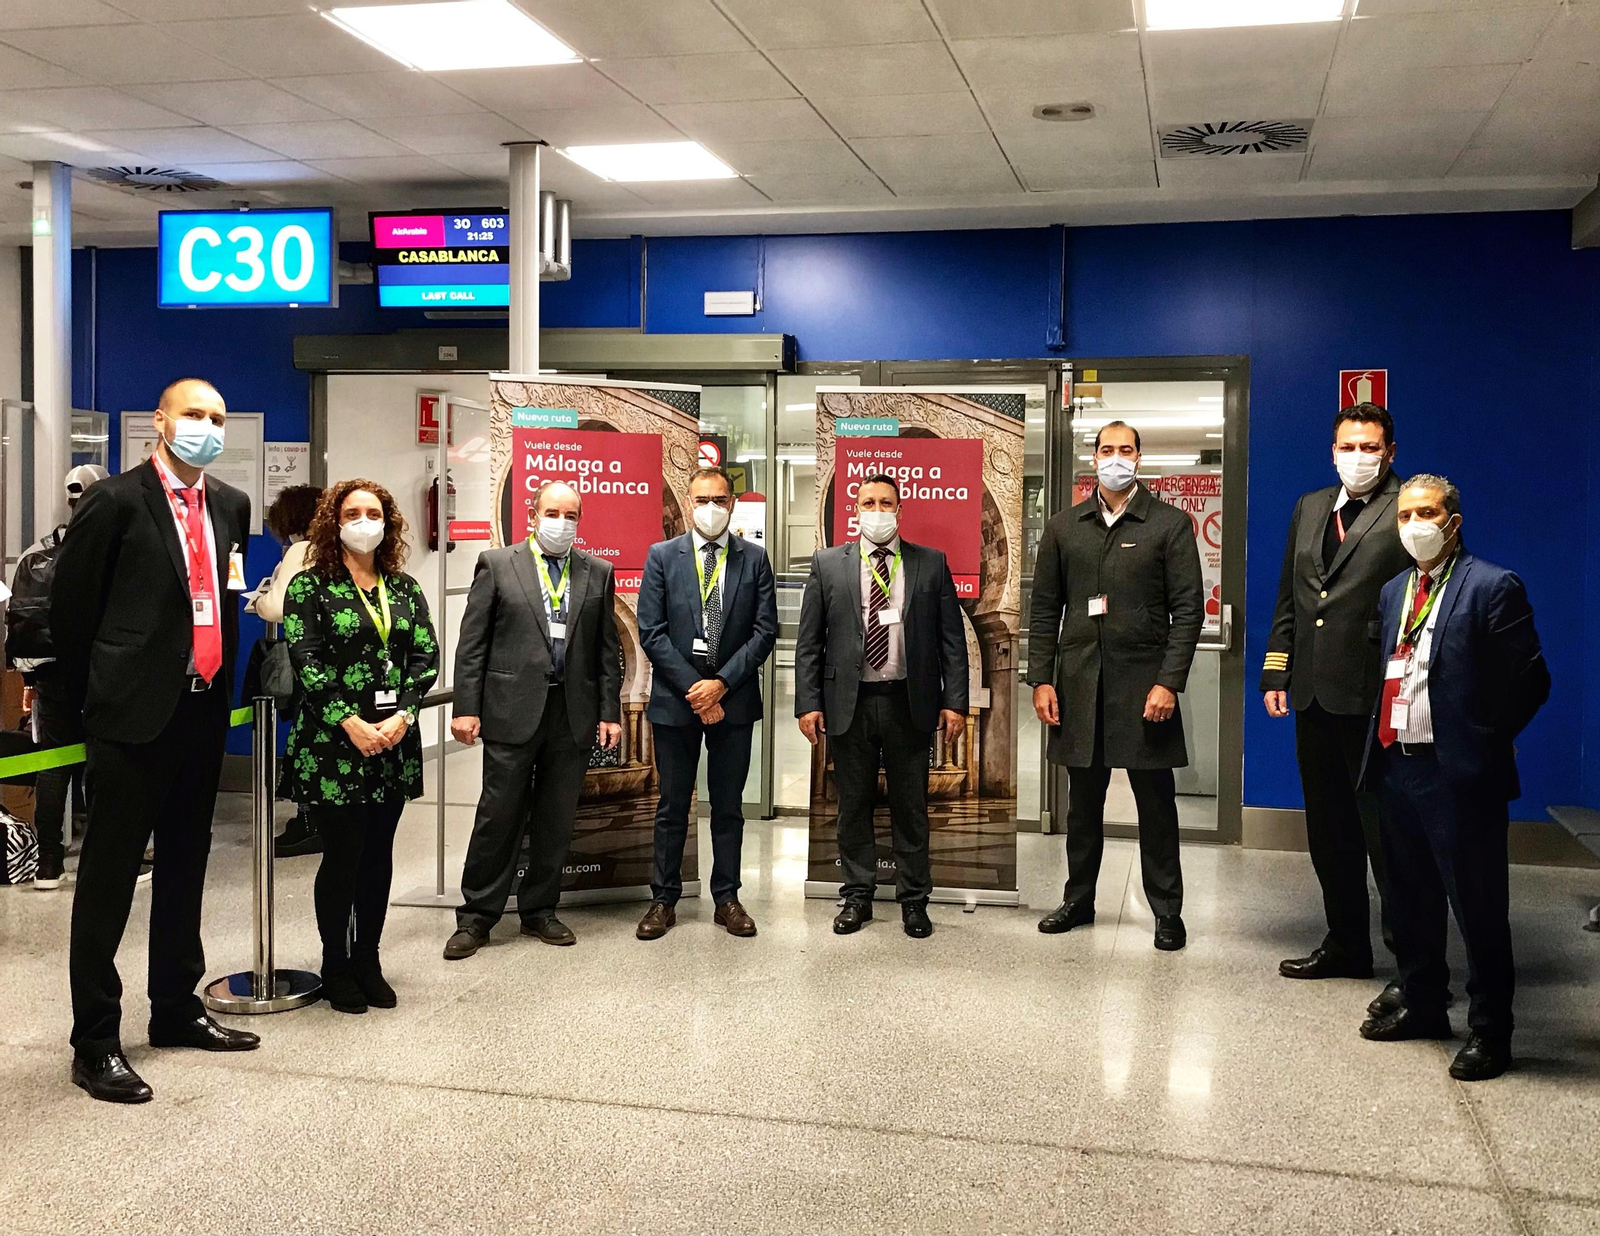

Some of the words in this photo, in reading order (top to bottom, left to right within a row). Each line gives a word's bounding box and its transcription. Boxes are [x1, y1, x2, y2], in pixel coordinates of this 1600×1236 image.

[481, 217, 505, 229] 603
[392, 227, 428, 236] AirArabia
[467, 231, 494, 241] 21:25
[178, 224, 315, 292] C30
[398, 249, 500, 263] CASABLANCA
[421, 291, 447, 300] LAST
[449, 291, 476, 300] CALL
[517, 412, 549, 422] Nueva
[551, 414, 572, 423] ruta
[840, 422, 871, 431] Nueva
[872, 423, 893, 431] ruta
[524, 440, 552, 451] Vuele
[553, 441, 583, 451] desde
[846, 449, 872, 458] Vuele
[874, 449, 903, 458] desde
[525, 454, 604, 476] Málaga
[609, 460, 622, 474] a
[847, 461, 924, 483] Málaga
[928, 466, 942, 479] a
[525, 475, 649, 495] Cablanca
[846, 482, 969, 500] Cblanca
[1181, 497, 1207, 513] ONLY
